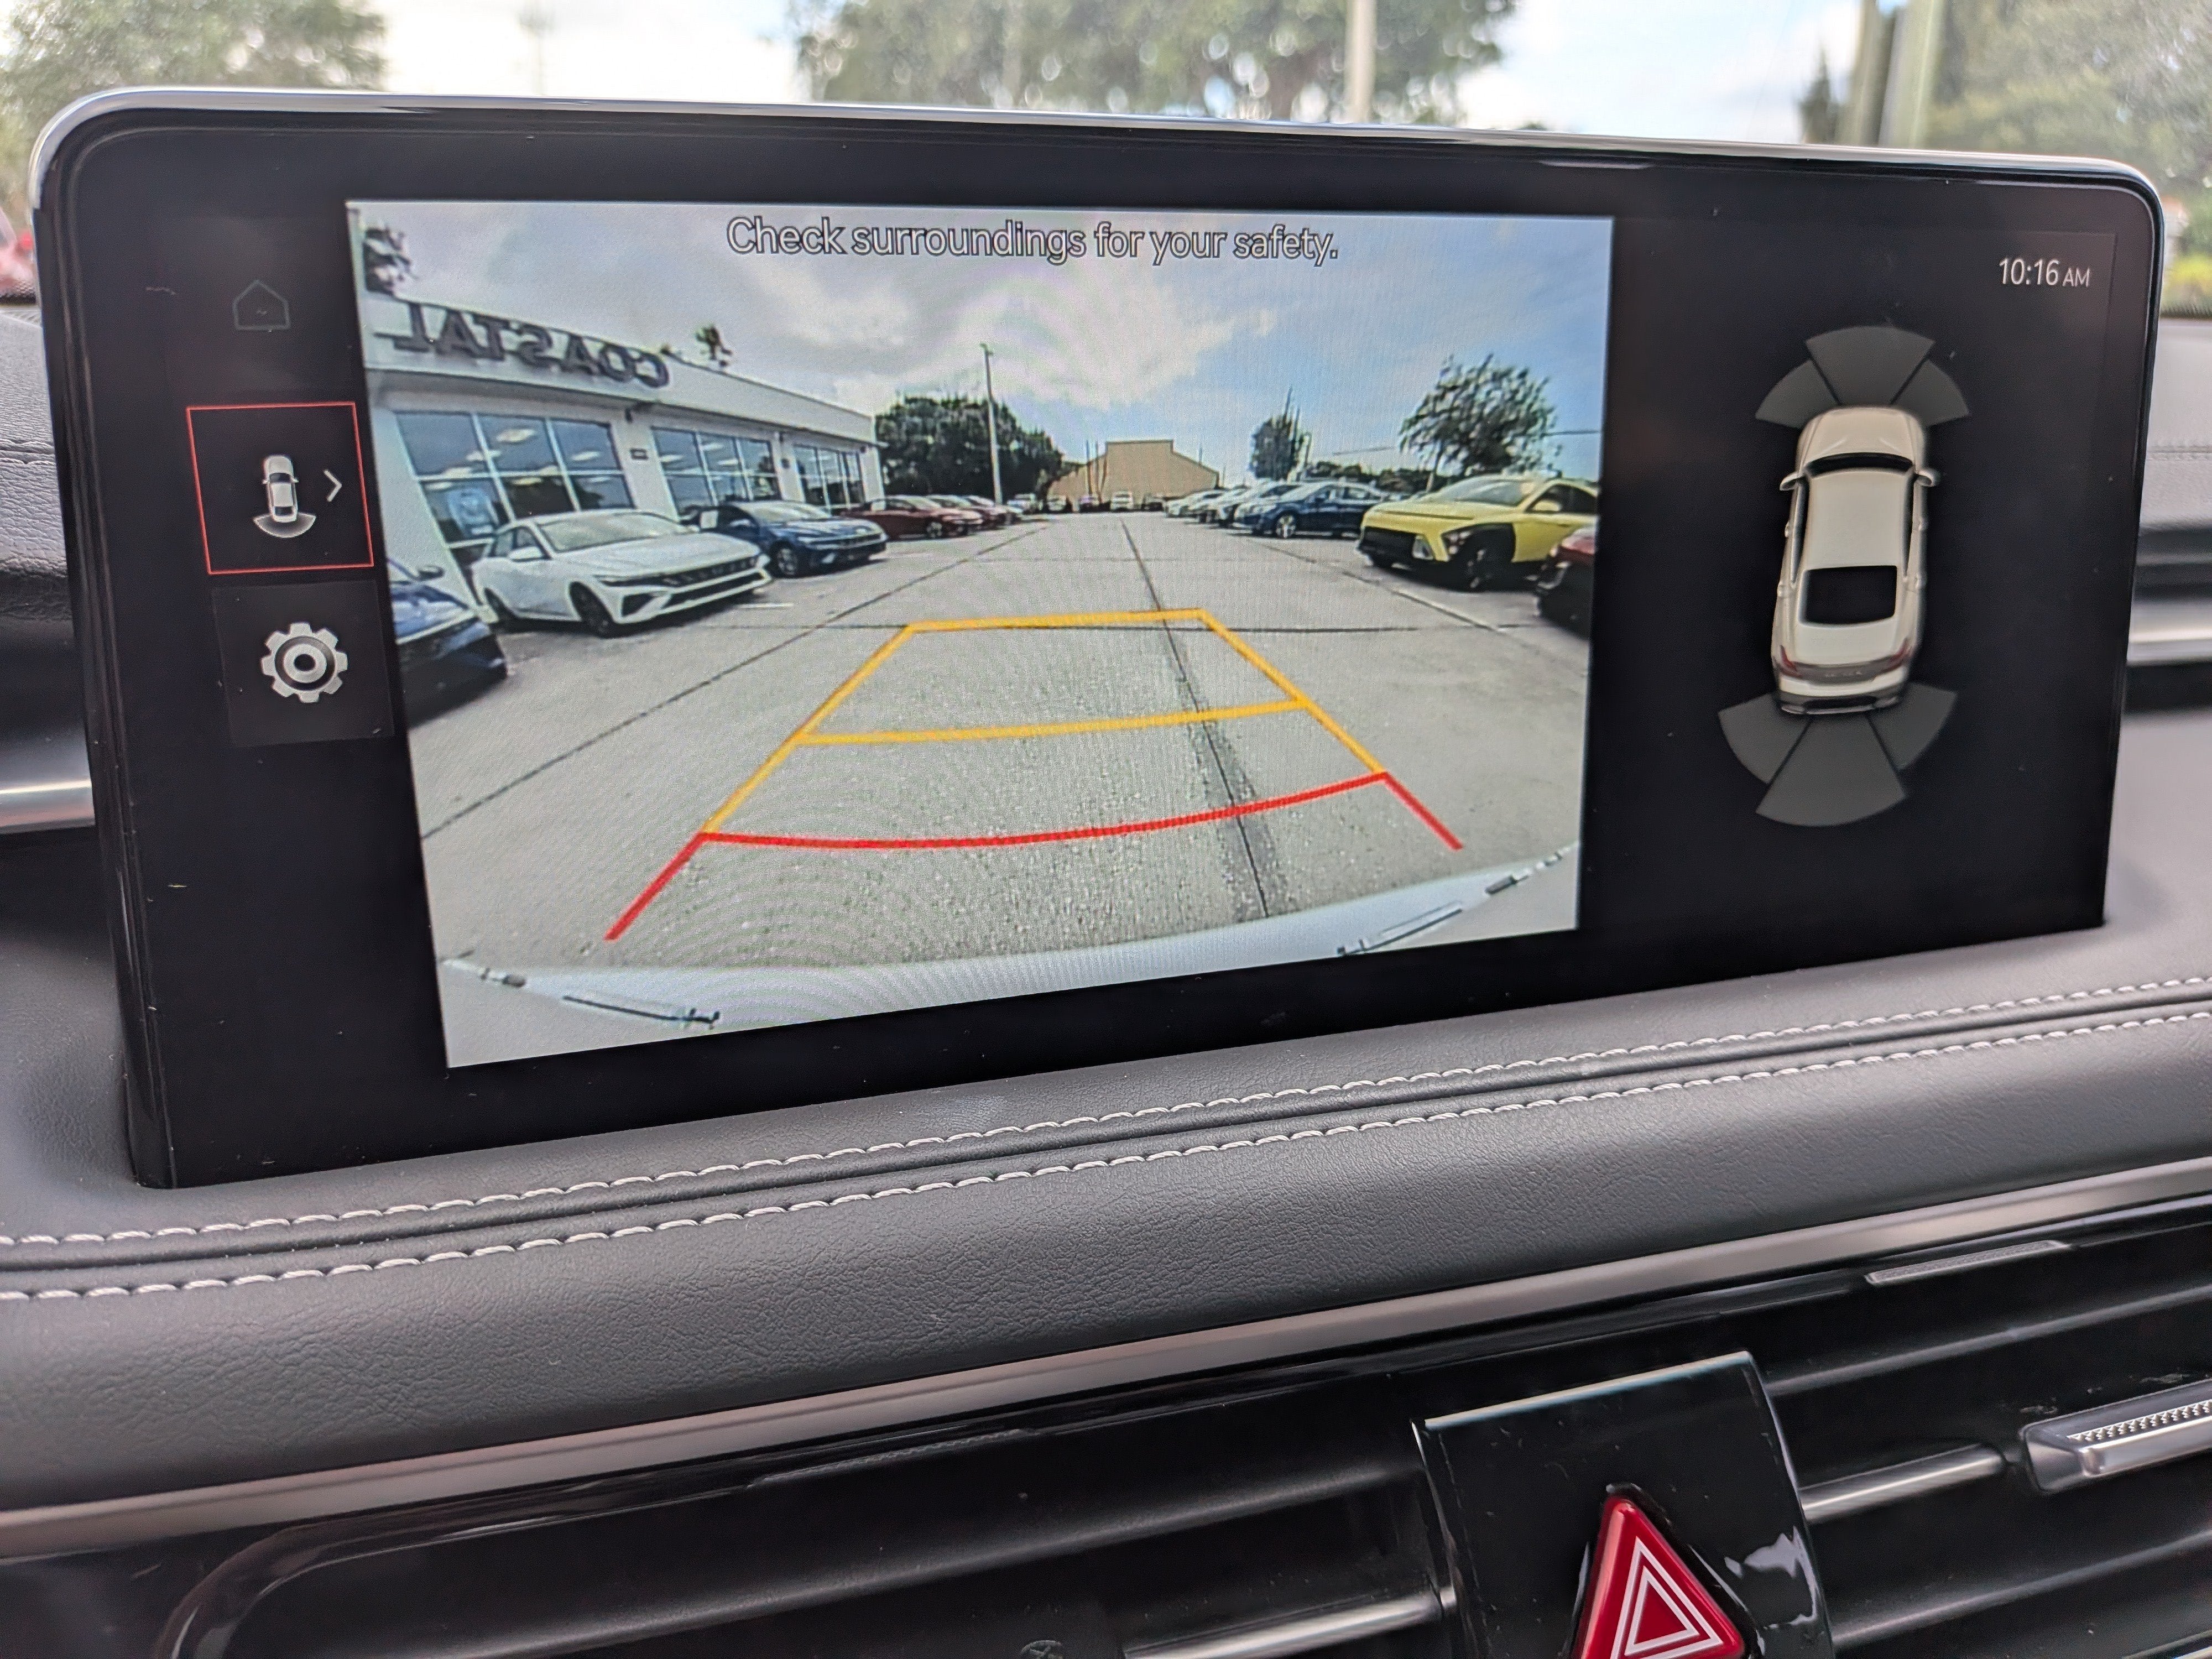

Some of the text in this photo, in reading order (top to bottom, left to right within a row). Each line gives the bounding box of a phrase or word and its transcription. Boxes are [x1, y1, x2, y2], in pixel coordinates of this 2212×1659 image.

[726, 215, 1338, 267] Check surroundings for your safety.
[1999, 258, 2090, 287] 10:16 AM
